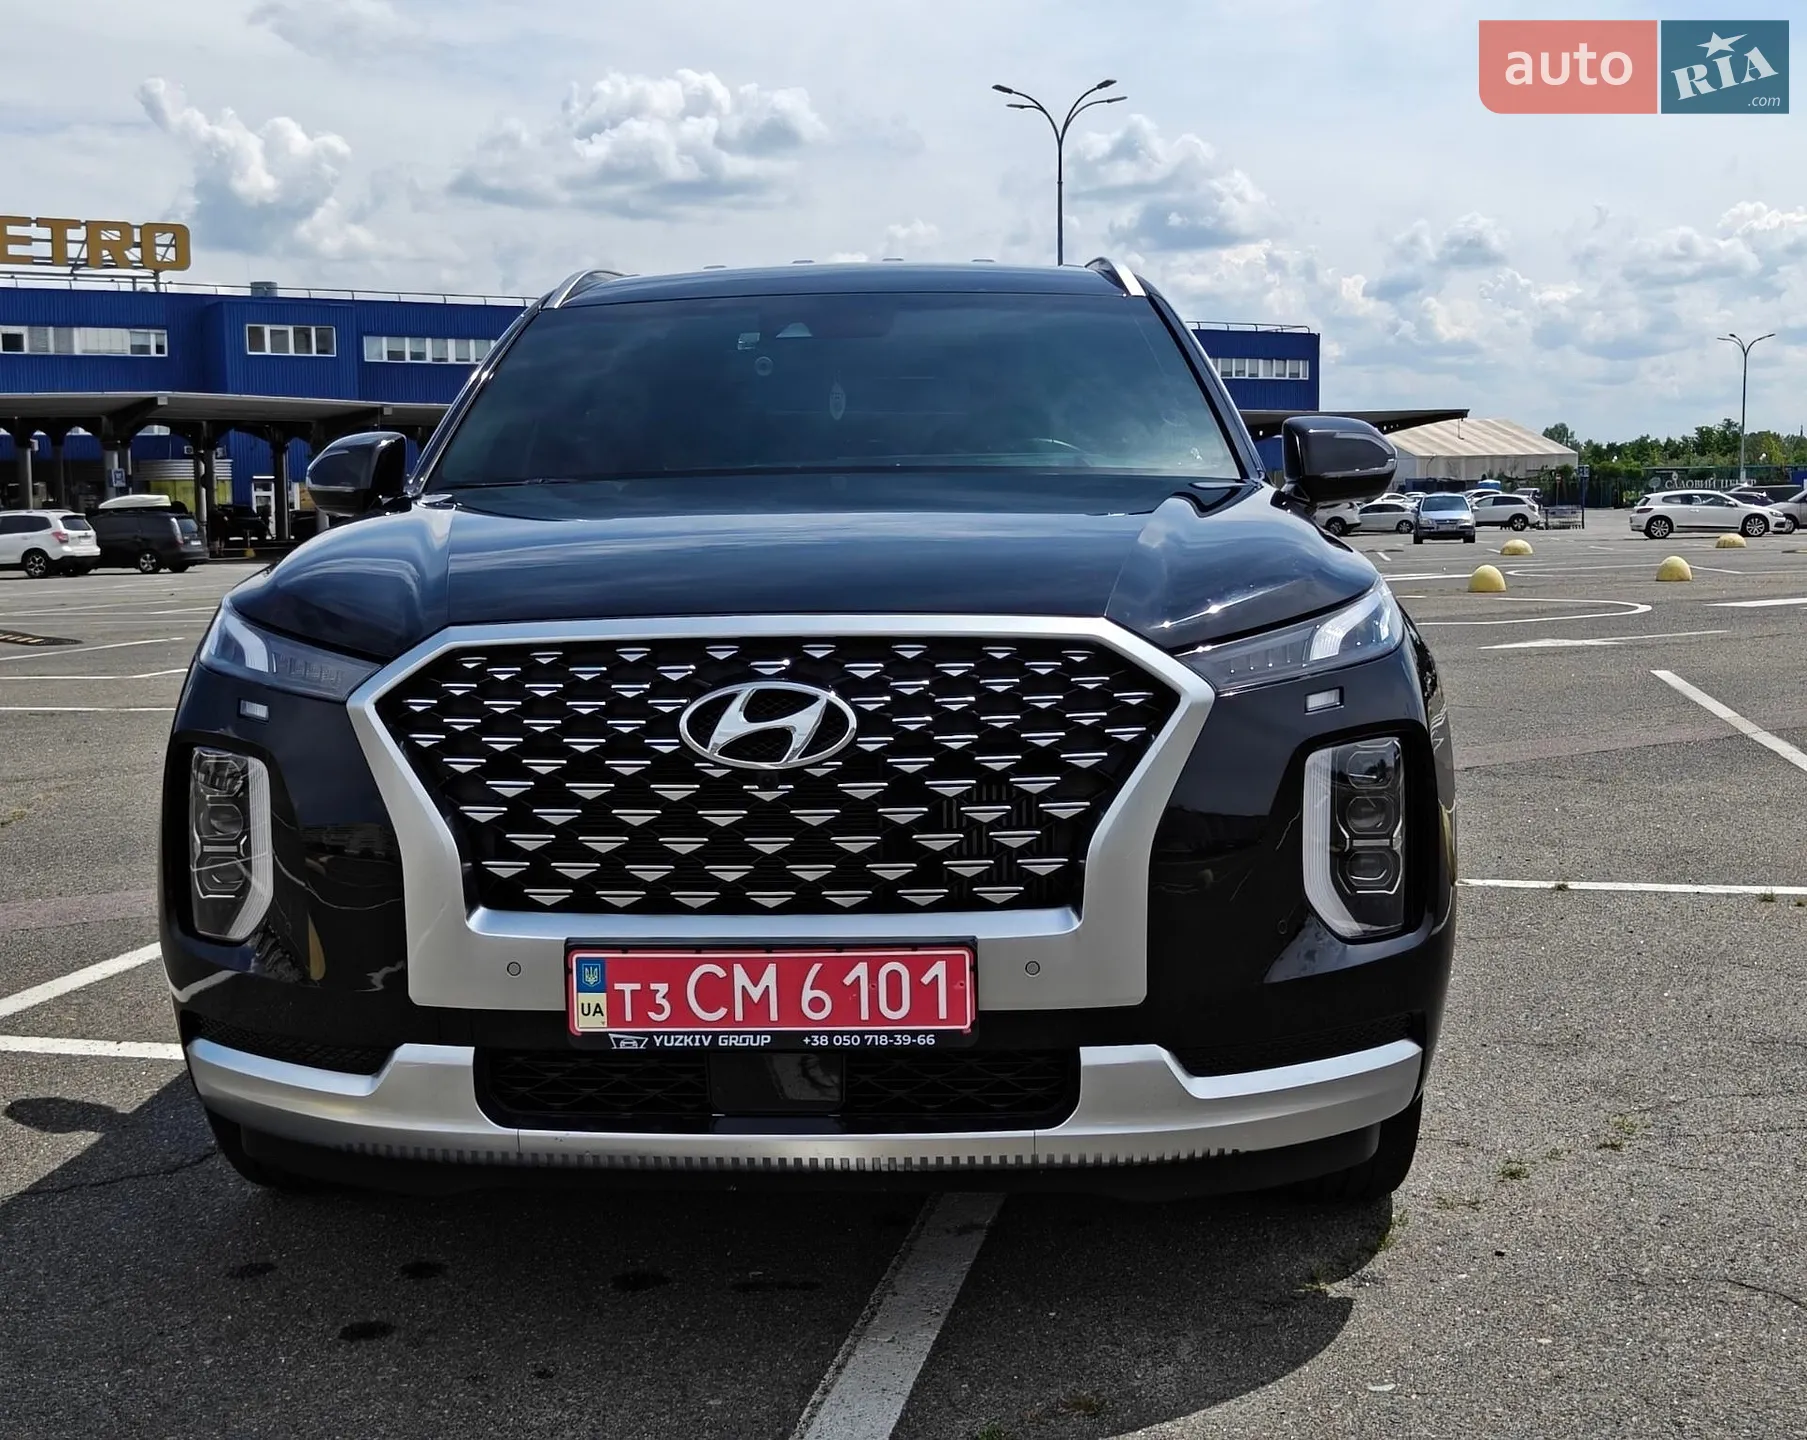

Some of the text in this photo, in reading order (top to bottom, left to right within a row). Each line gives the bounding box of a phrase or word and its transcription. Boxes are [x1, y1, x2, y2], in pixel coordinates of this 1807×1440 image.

[686, 963, 779, 1022] CM
[800, 960, 948, 1021] 6101
[581, 1002, 604, 1017] UA
[653, 1034, 772, 1047] YUZKIV GROUP
[802, 1033, 936, 1047] +38 050 718-39-66
